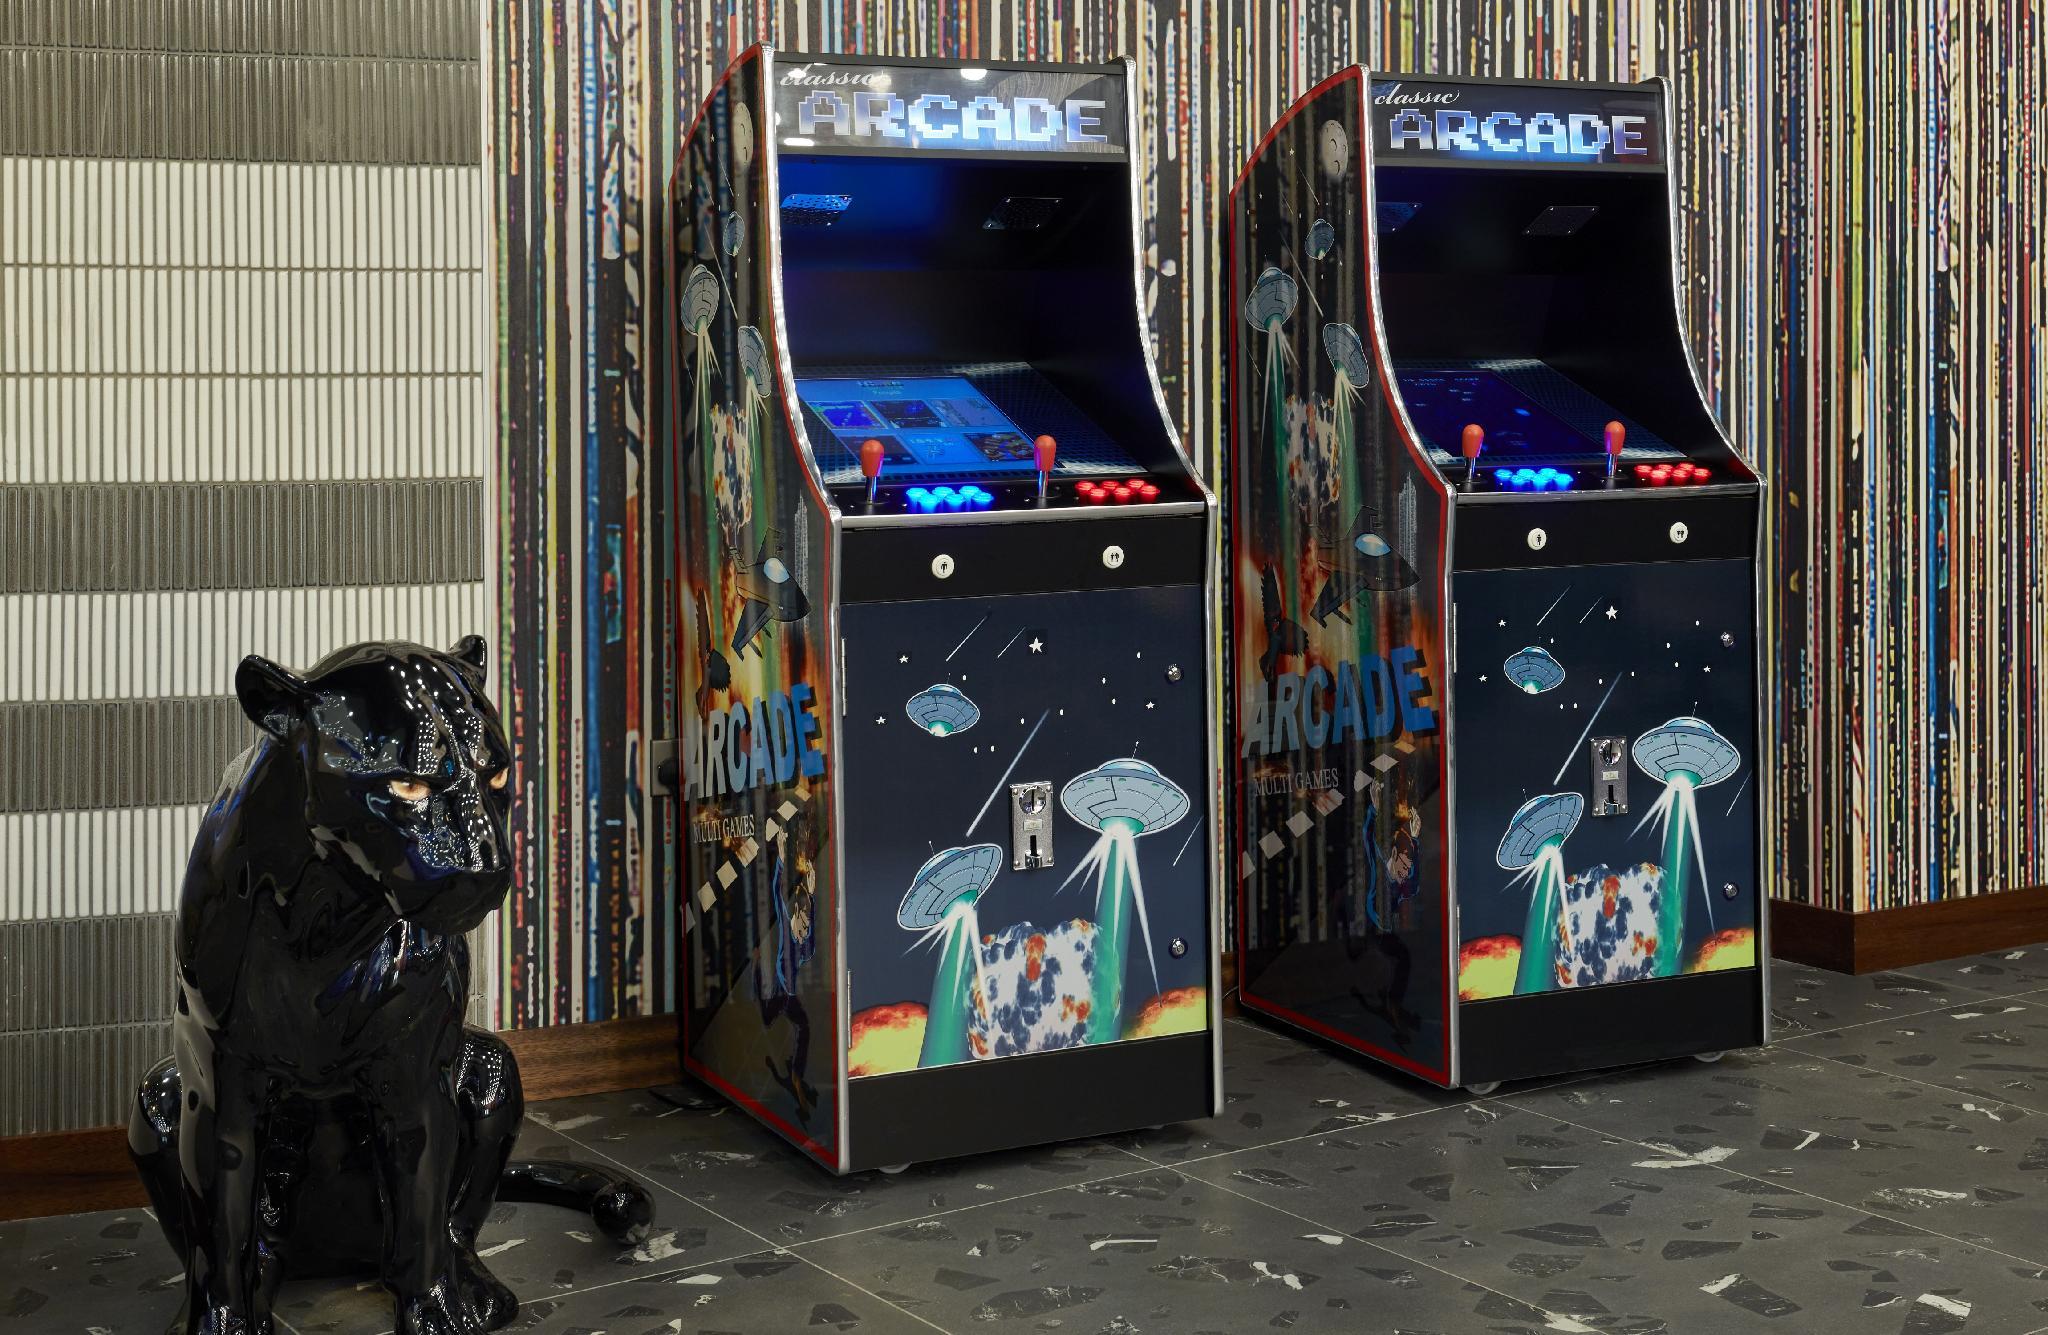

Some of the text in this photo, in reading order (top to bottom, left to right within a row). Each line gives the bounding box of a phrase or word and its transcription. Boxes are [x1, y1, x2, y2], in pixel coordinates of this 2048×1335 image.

[798, 90, 1108, 143] ARCADE
[1375, 83, 1460, 106] classic
[1389, 108, 1648, 156] ARCADE
[1241, 644, 1435, 759] ARCADE
[683, 682, 825, 802] ARCADE
[1254, 767, 1339, 797] MULTI GAMES
[693, 814, 755, 843] MULTI GAMES
